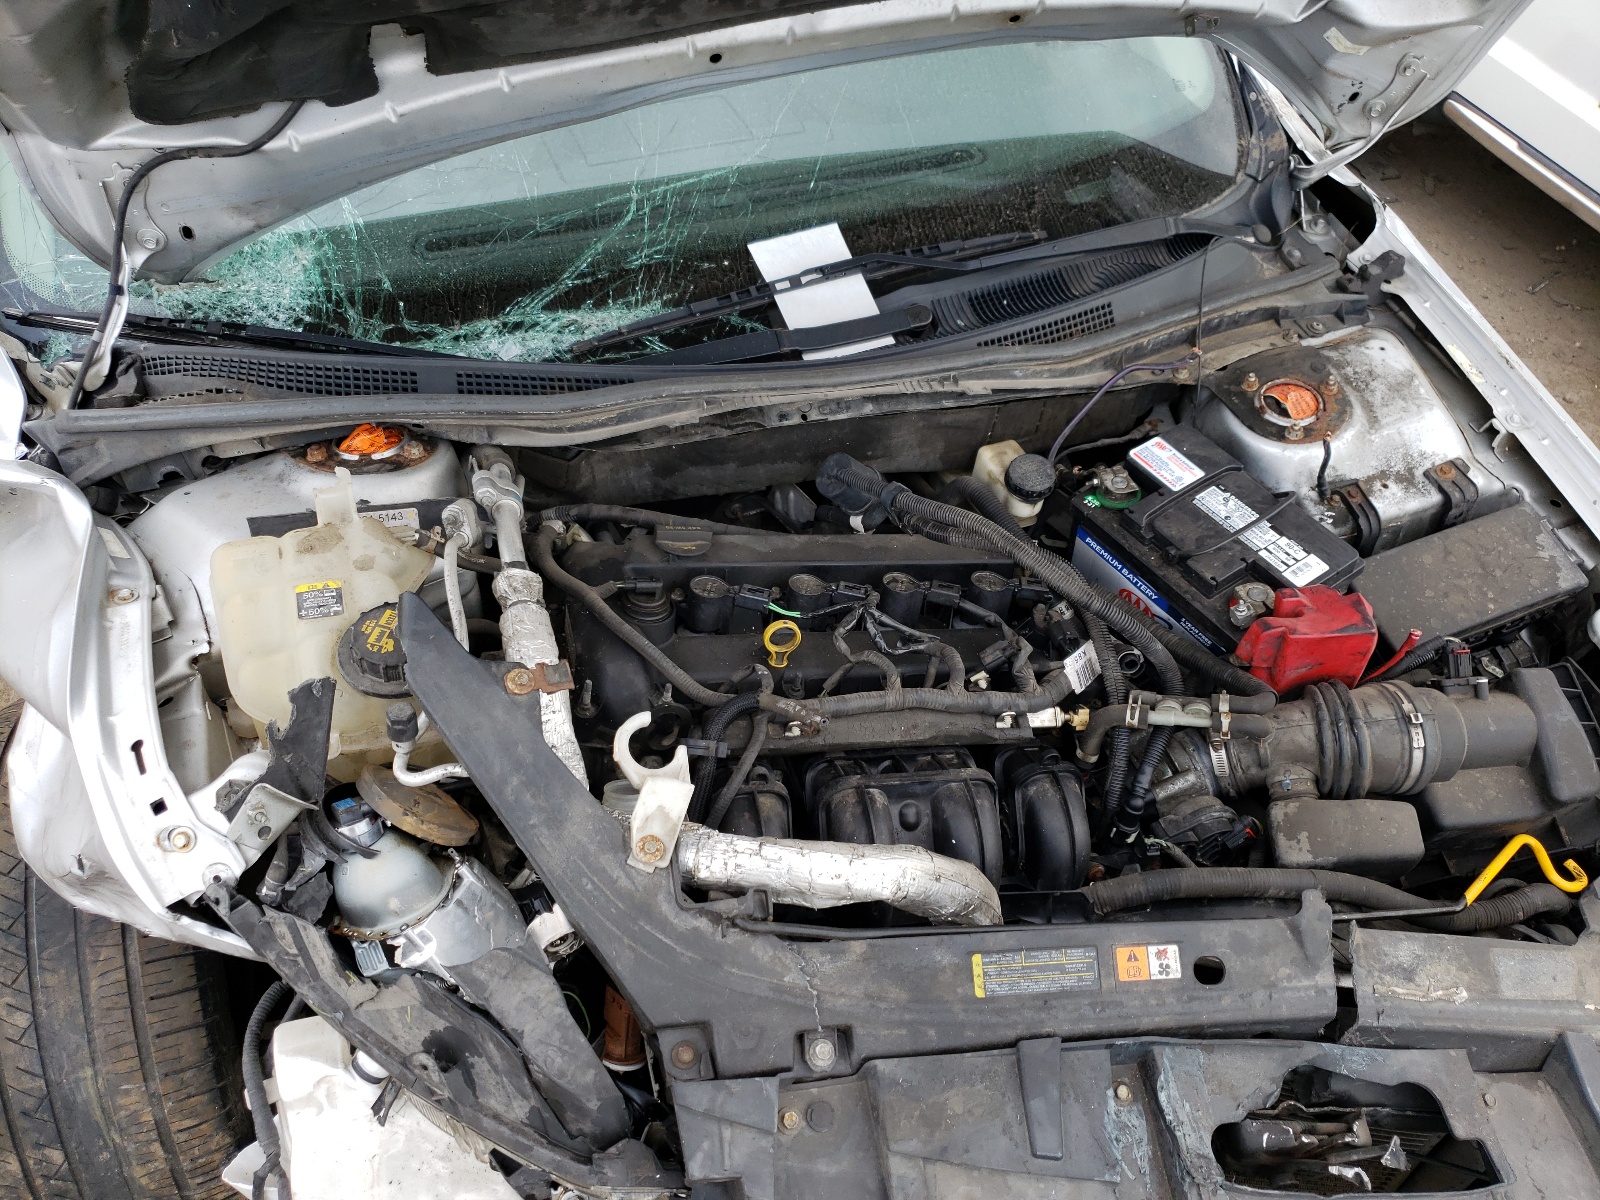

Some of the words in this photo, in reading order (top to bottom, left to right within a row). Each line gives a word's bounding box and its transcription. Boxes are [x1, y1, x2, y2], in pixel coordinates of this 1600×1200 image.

[378, 511, 404, 523] 5143
[1085, 536, 1122, 570] PREMIUM
[1121, 568, 1159, 601] BATTERY
